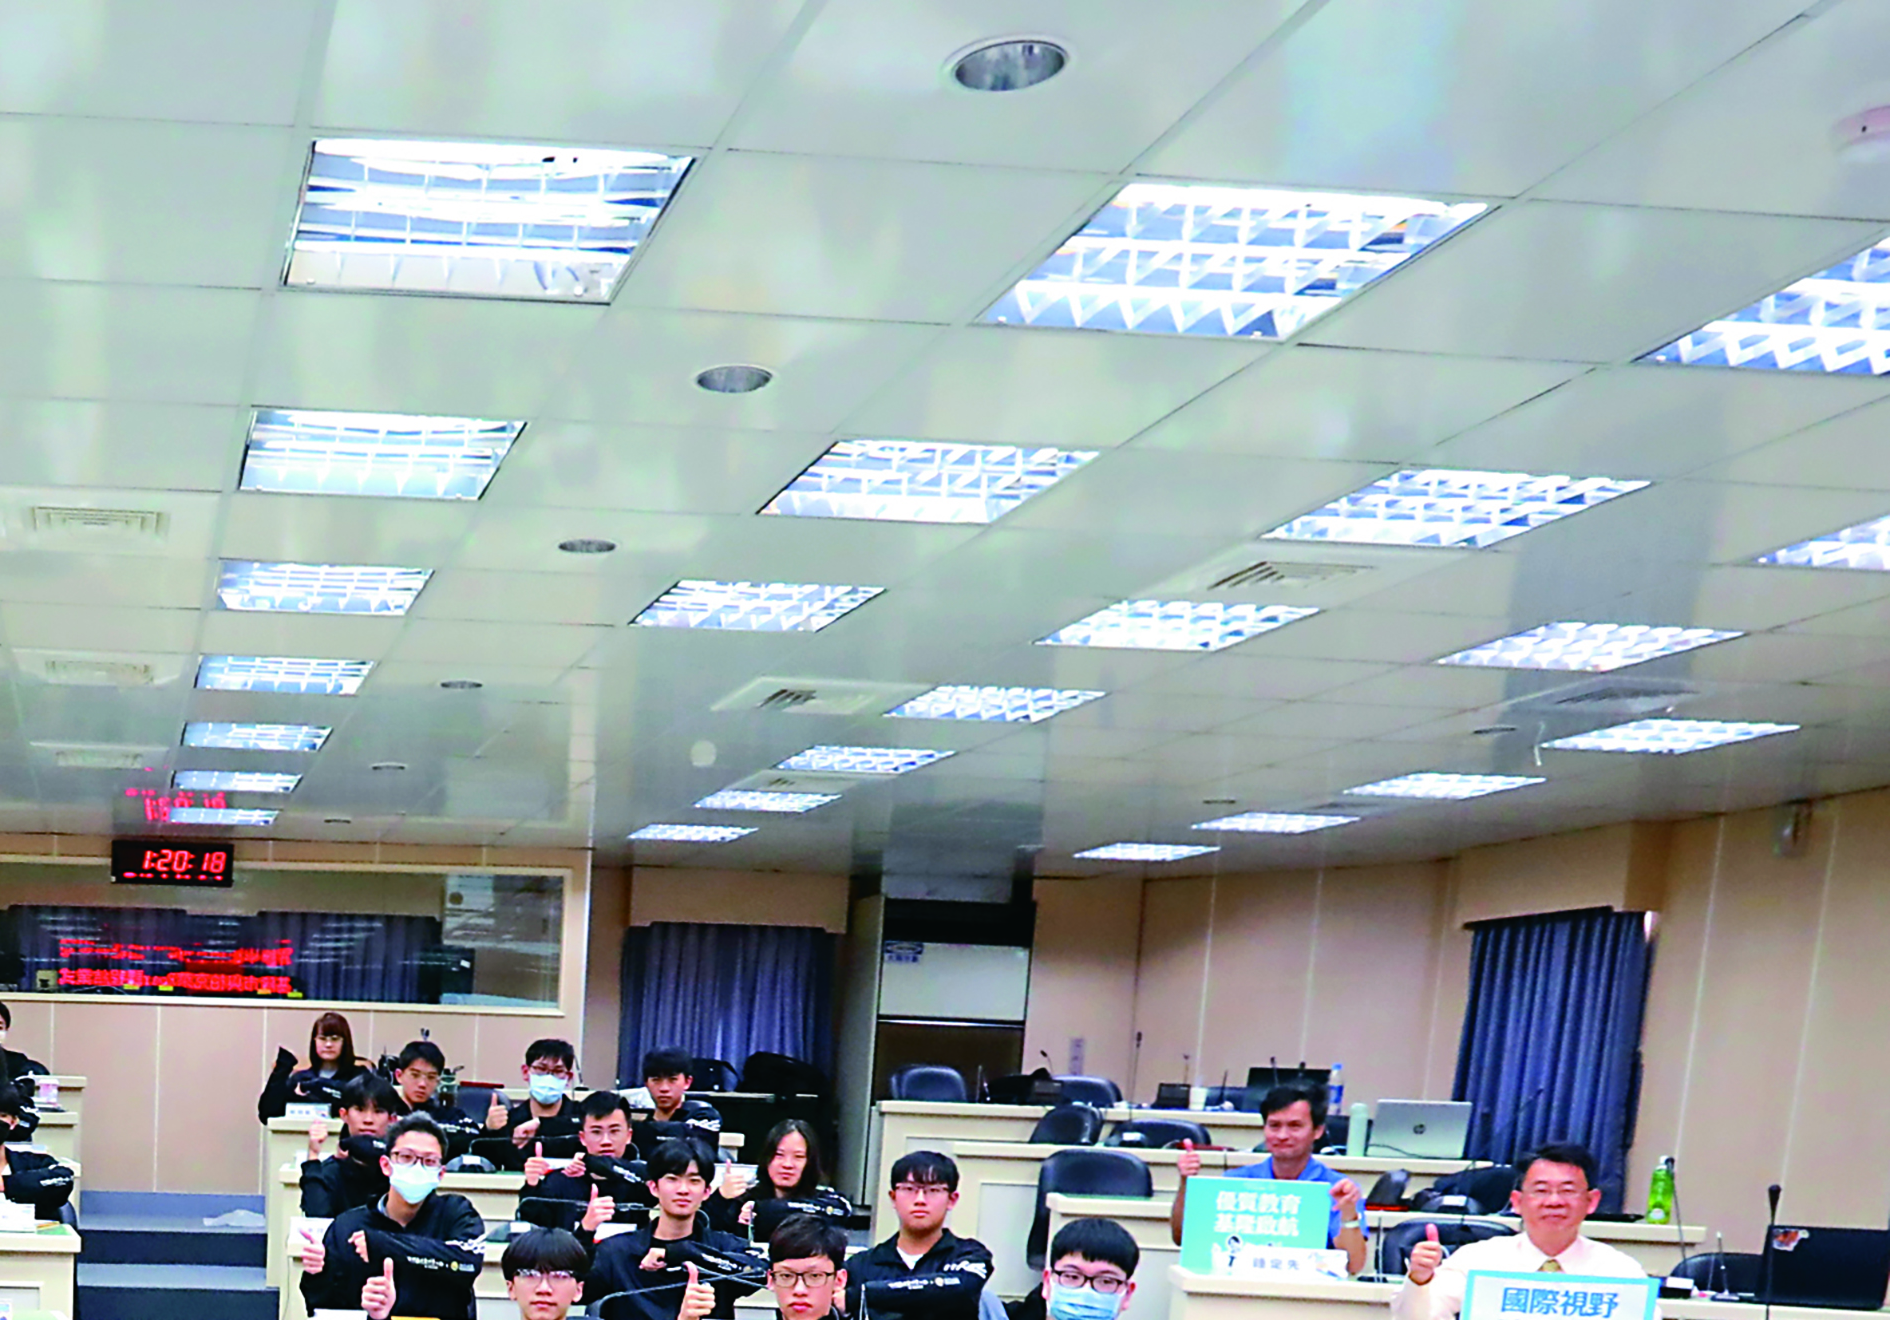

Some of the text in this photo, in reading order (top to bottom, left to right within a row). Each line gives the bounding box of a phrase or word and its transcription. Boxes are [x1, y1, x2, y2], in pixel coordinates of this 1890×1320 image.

[142, 849, 227, 874] 1:20:18
[1216, 1190, 1302, 1215] 優質教育
[1500, 1286, 1619, 1319] 國際視野
